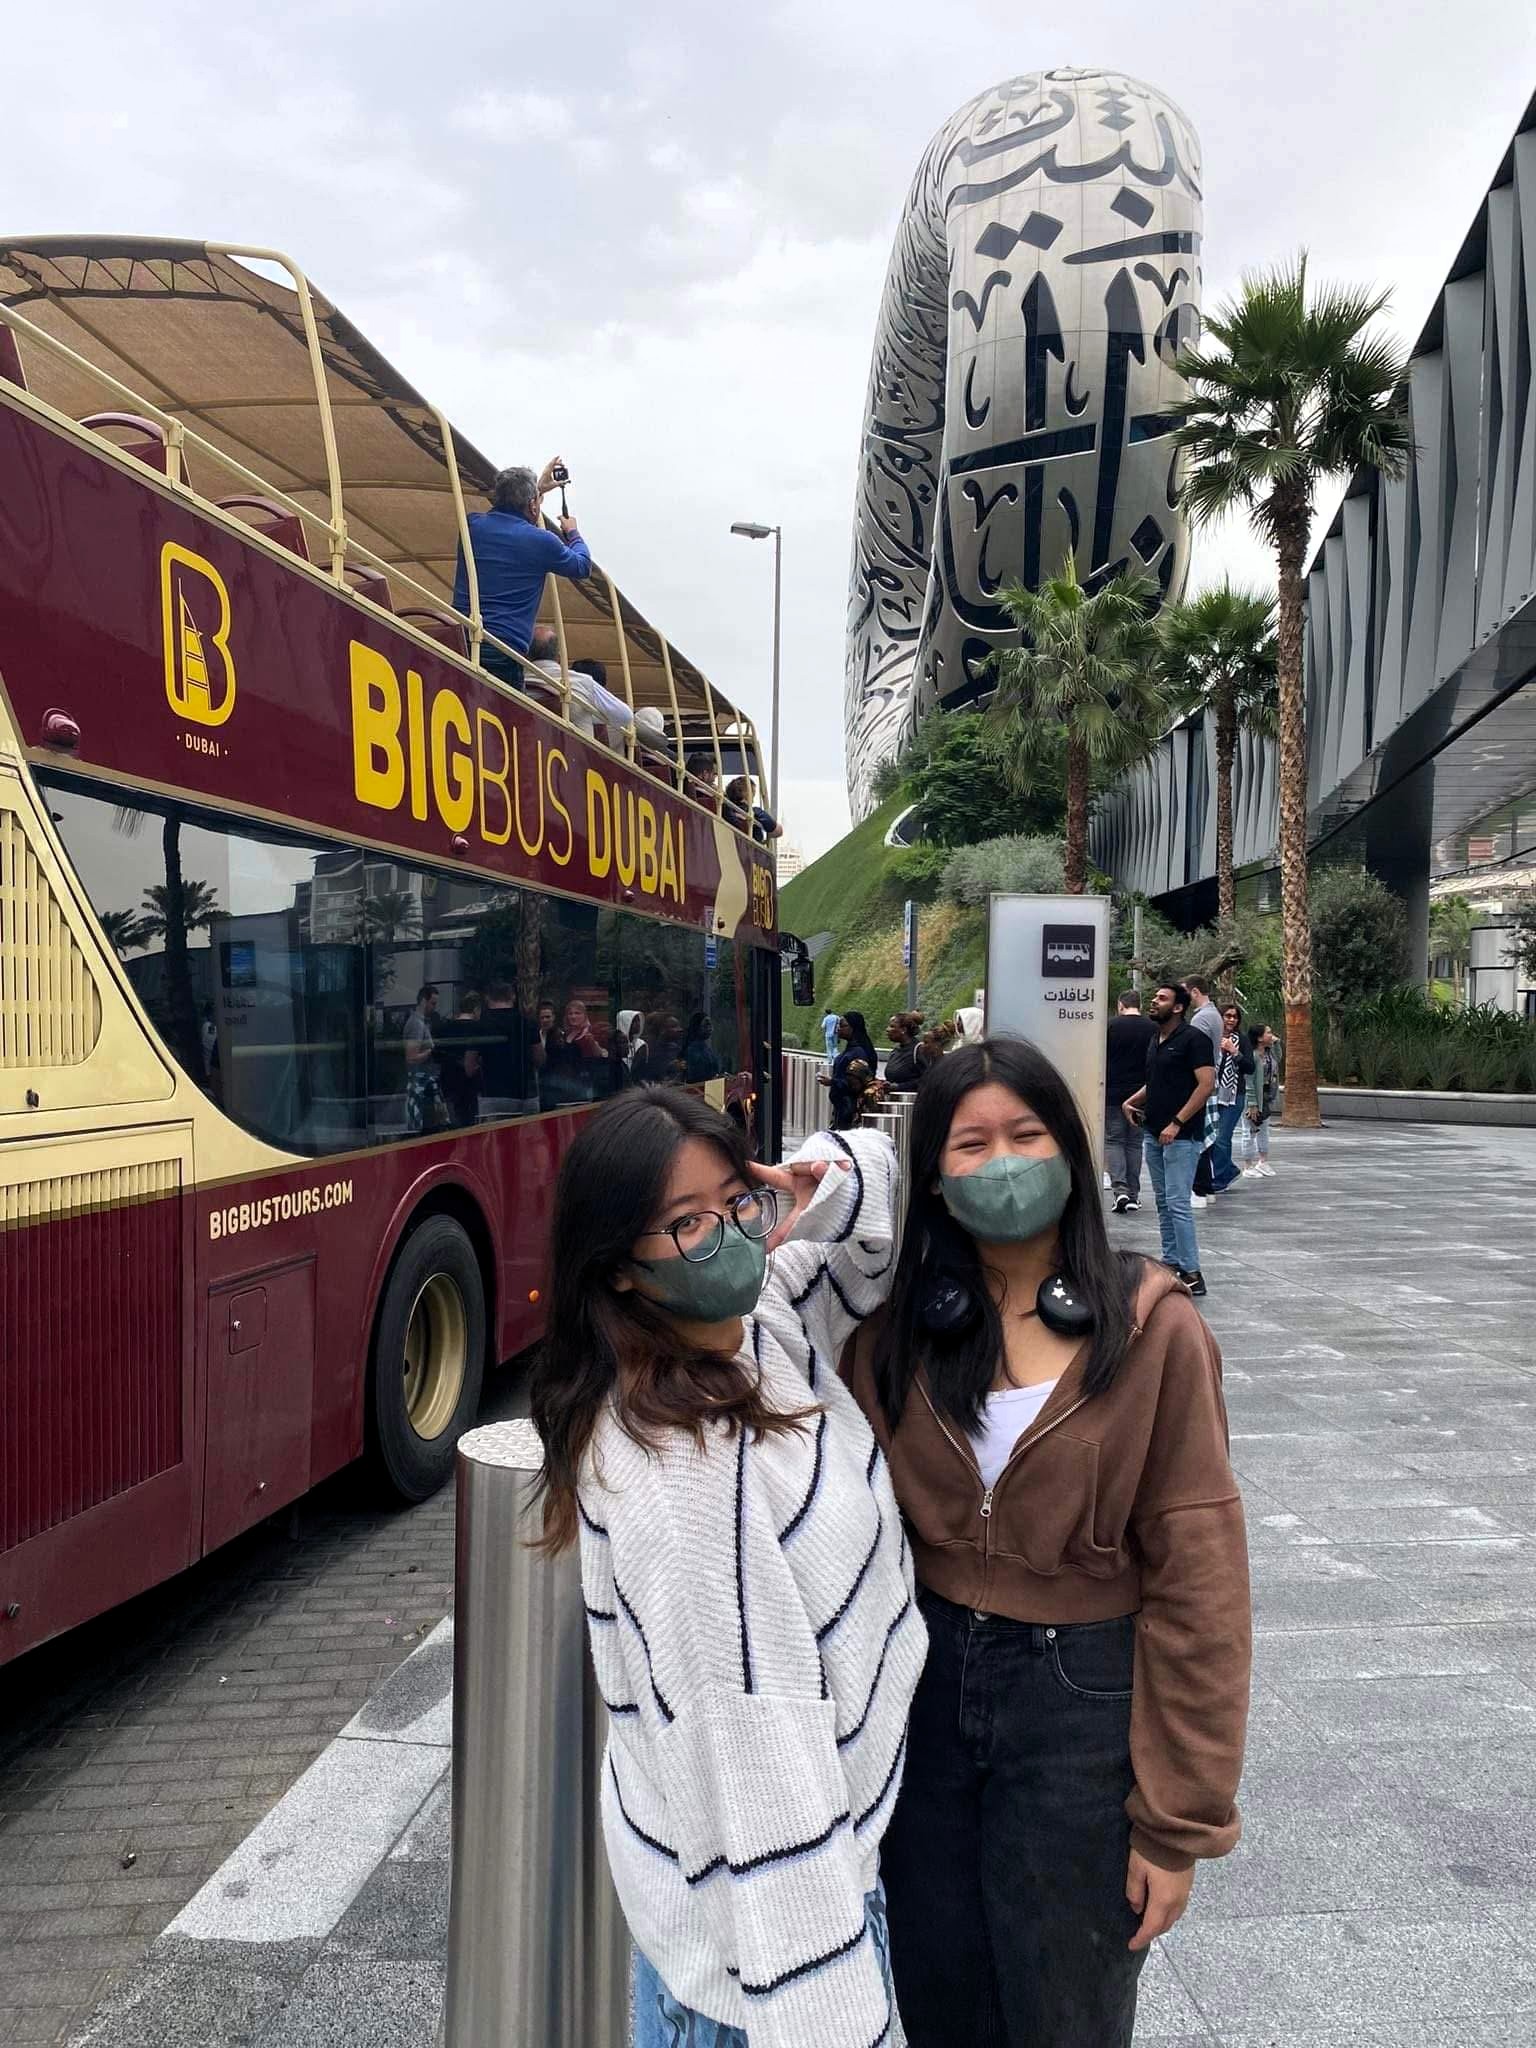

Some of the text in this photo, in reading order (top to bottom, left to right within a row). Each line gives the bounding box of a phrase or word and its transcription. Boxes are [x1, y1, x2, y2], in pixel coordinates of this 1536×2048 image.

[185, 733, 220, 757] DUBAI
[586, 768, 685, 904] DUBAI
[1044, 987, 1095, 1002] الحافلات
[1058, 1008, 1094, 1020] Buses
[209, 1179, 353, 1240] BIGBUSTOURS.COM
